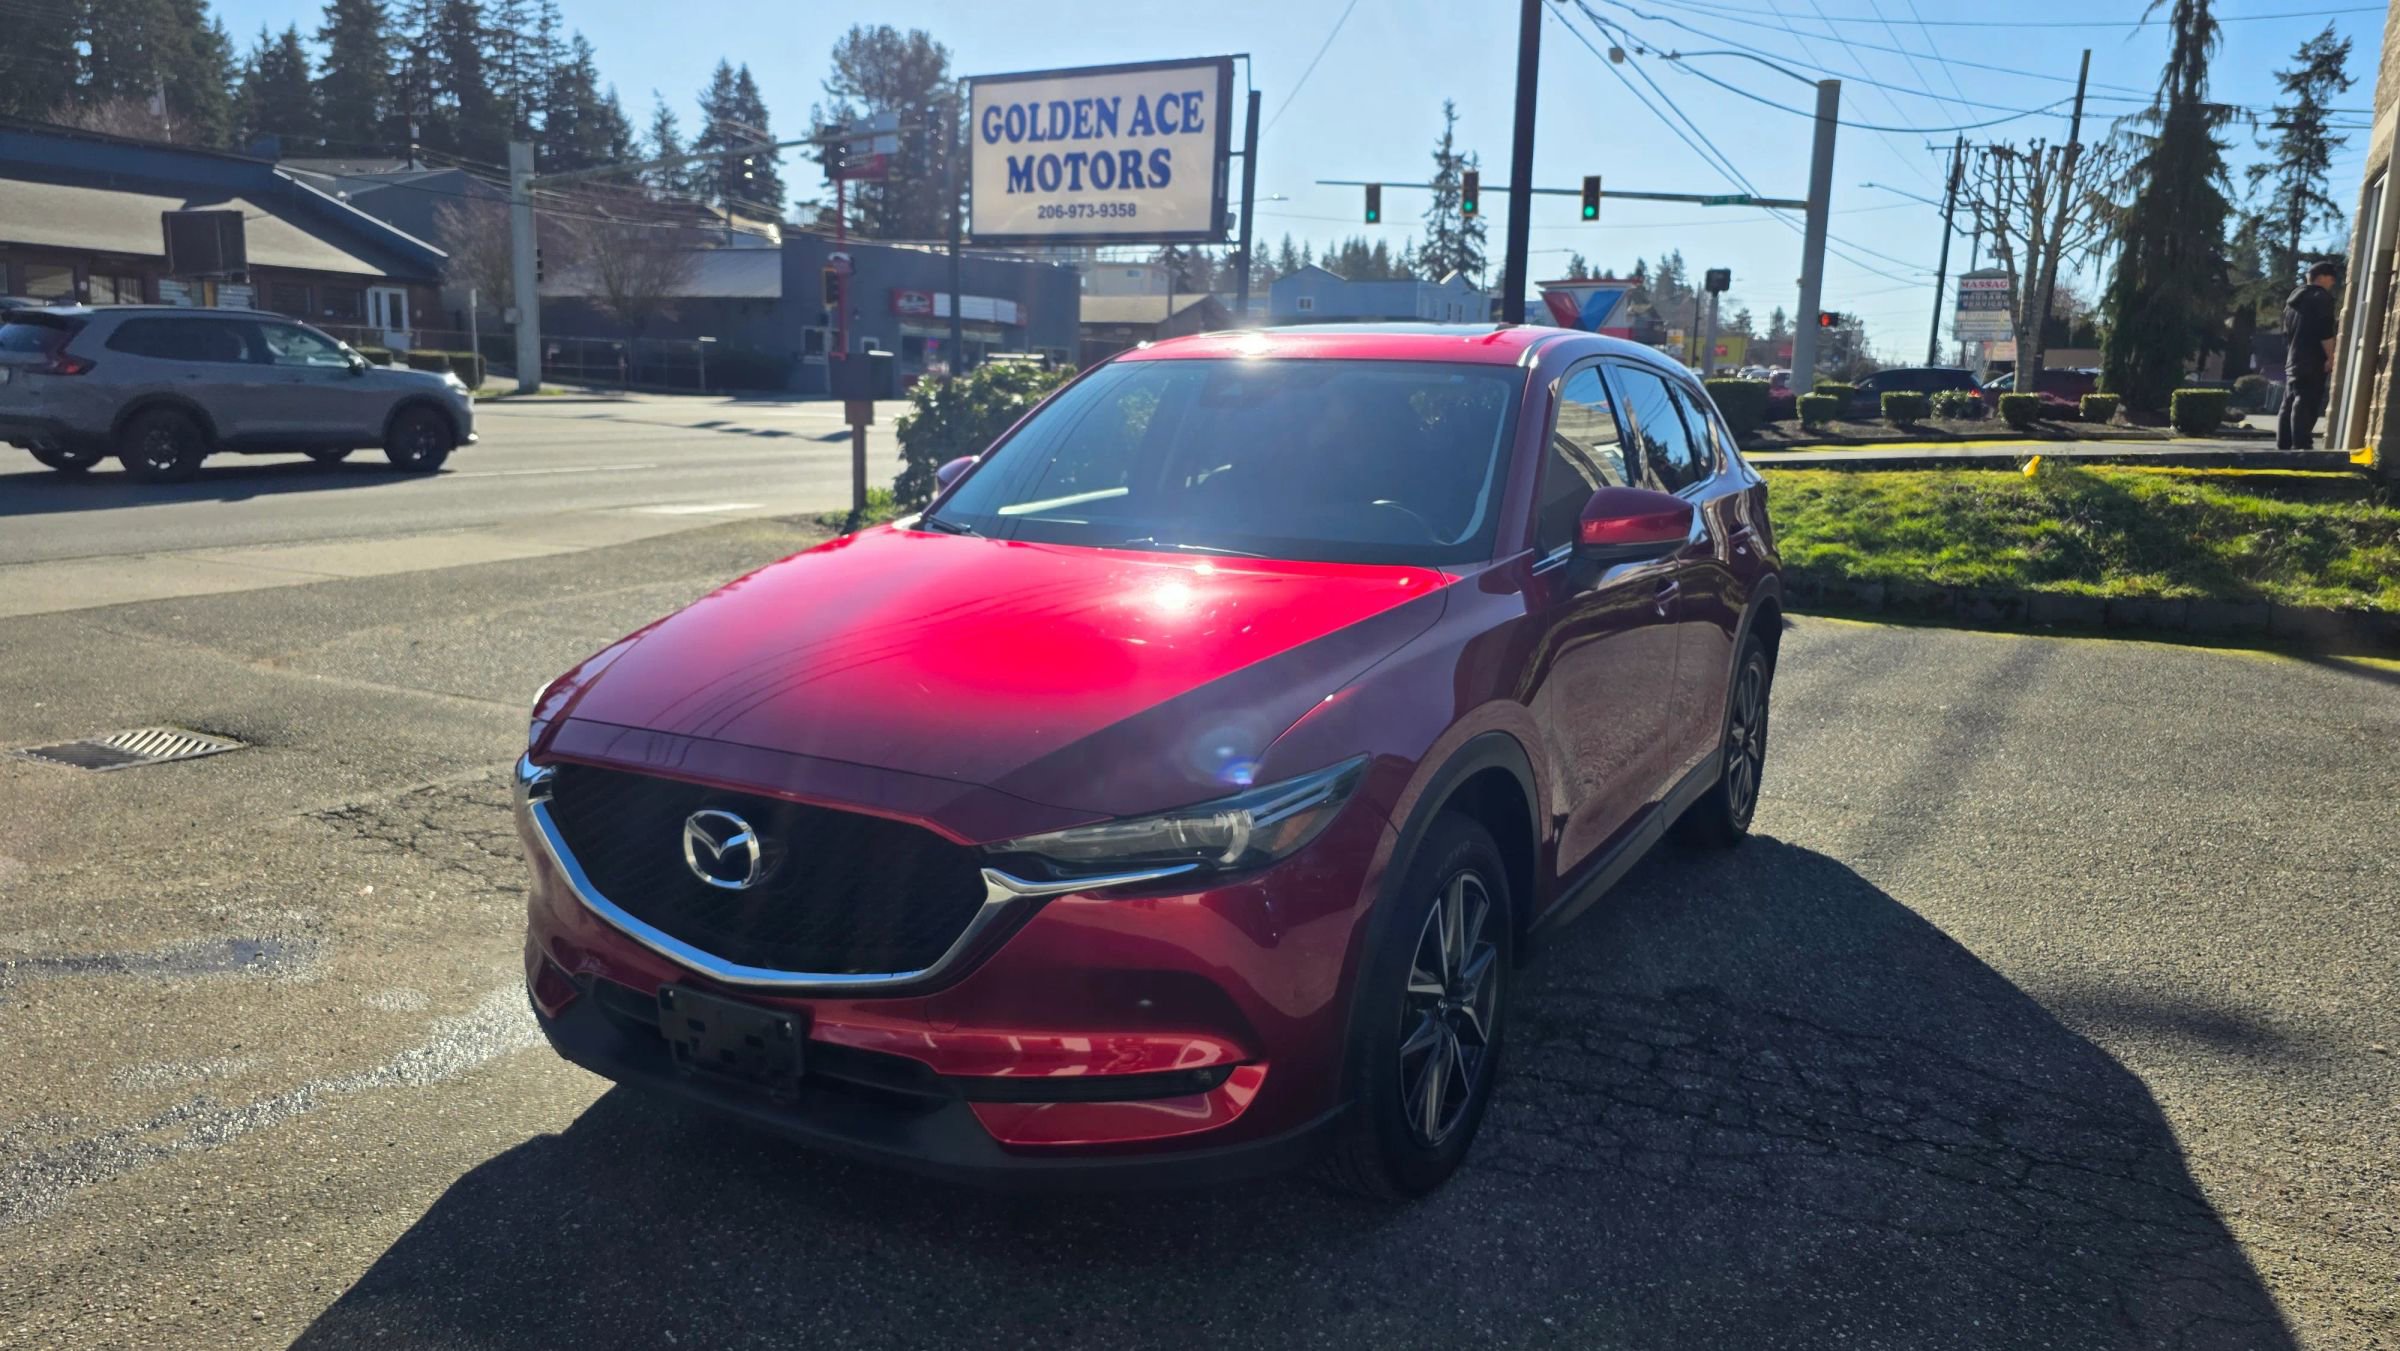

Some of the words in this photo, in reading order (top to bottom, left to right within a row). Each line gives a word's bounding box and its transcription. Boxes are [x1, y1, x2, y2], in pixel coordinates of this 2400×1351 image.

[982, 96, 1121, 144] GOLDEN
[1128, 91, 1204, 137] ACE
[1006, 149, 1172, 194] MOTORS
[1038, 203, 1137, 219] 206-973-9358
[1961, 280, 2008, 289] MASSAG
